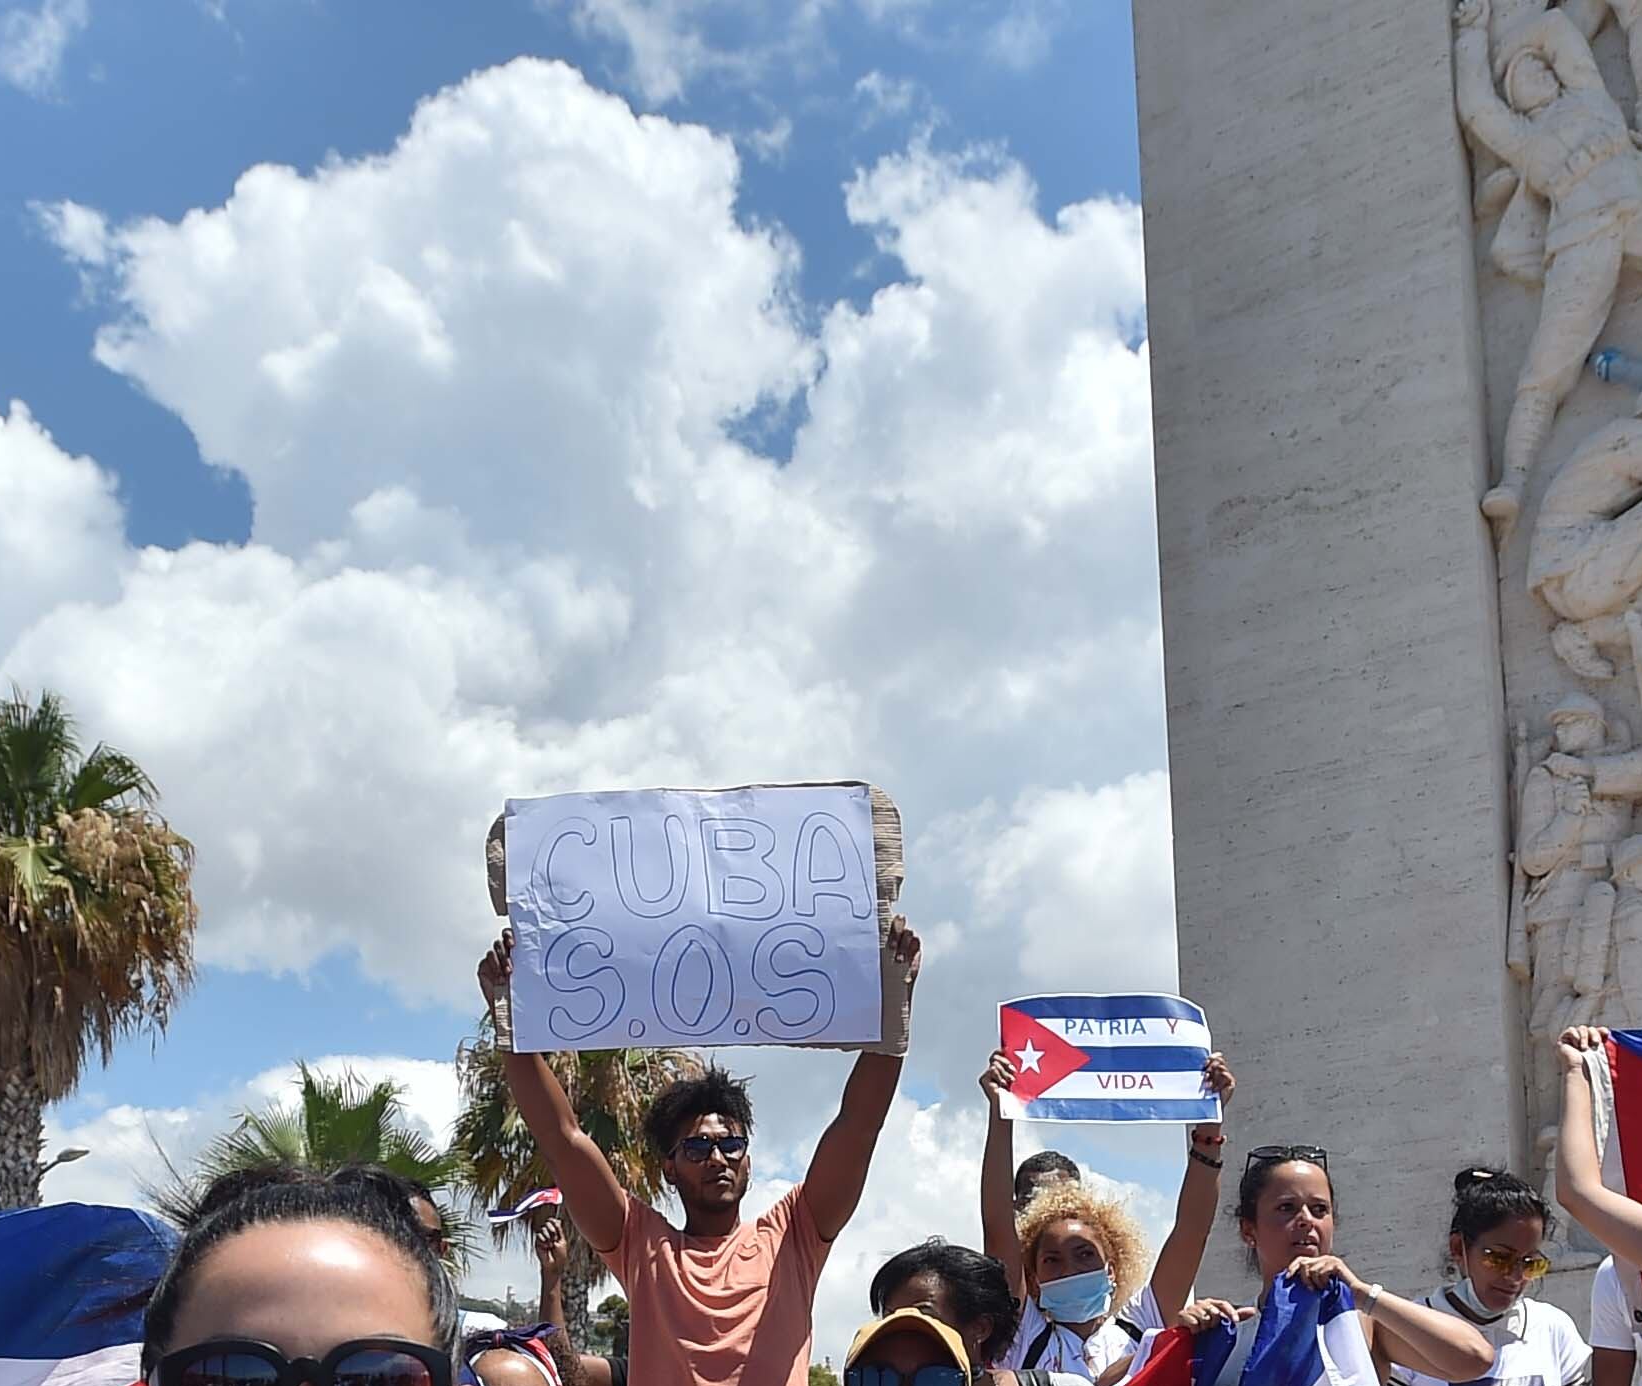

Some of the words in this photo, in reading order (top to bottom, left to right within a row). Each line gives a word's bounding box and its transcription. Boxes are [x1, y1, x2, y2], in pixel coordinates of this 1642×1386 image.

[531, 812, 873, 923] CUBA
[1064, 1017, 1147, 1035] PATRIA
[1166, 1018, 1179, 1035] Y
[1097, 1074, 1153, 1090] VIDA
